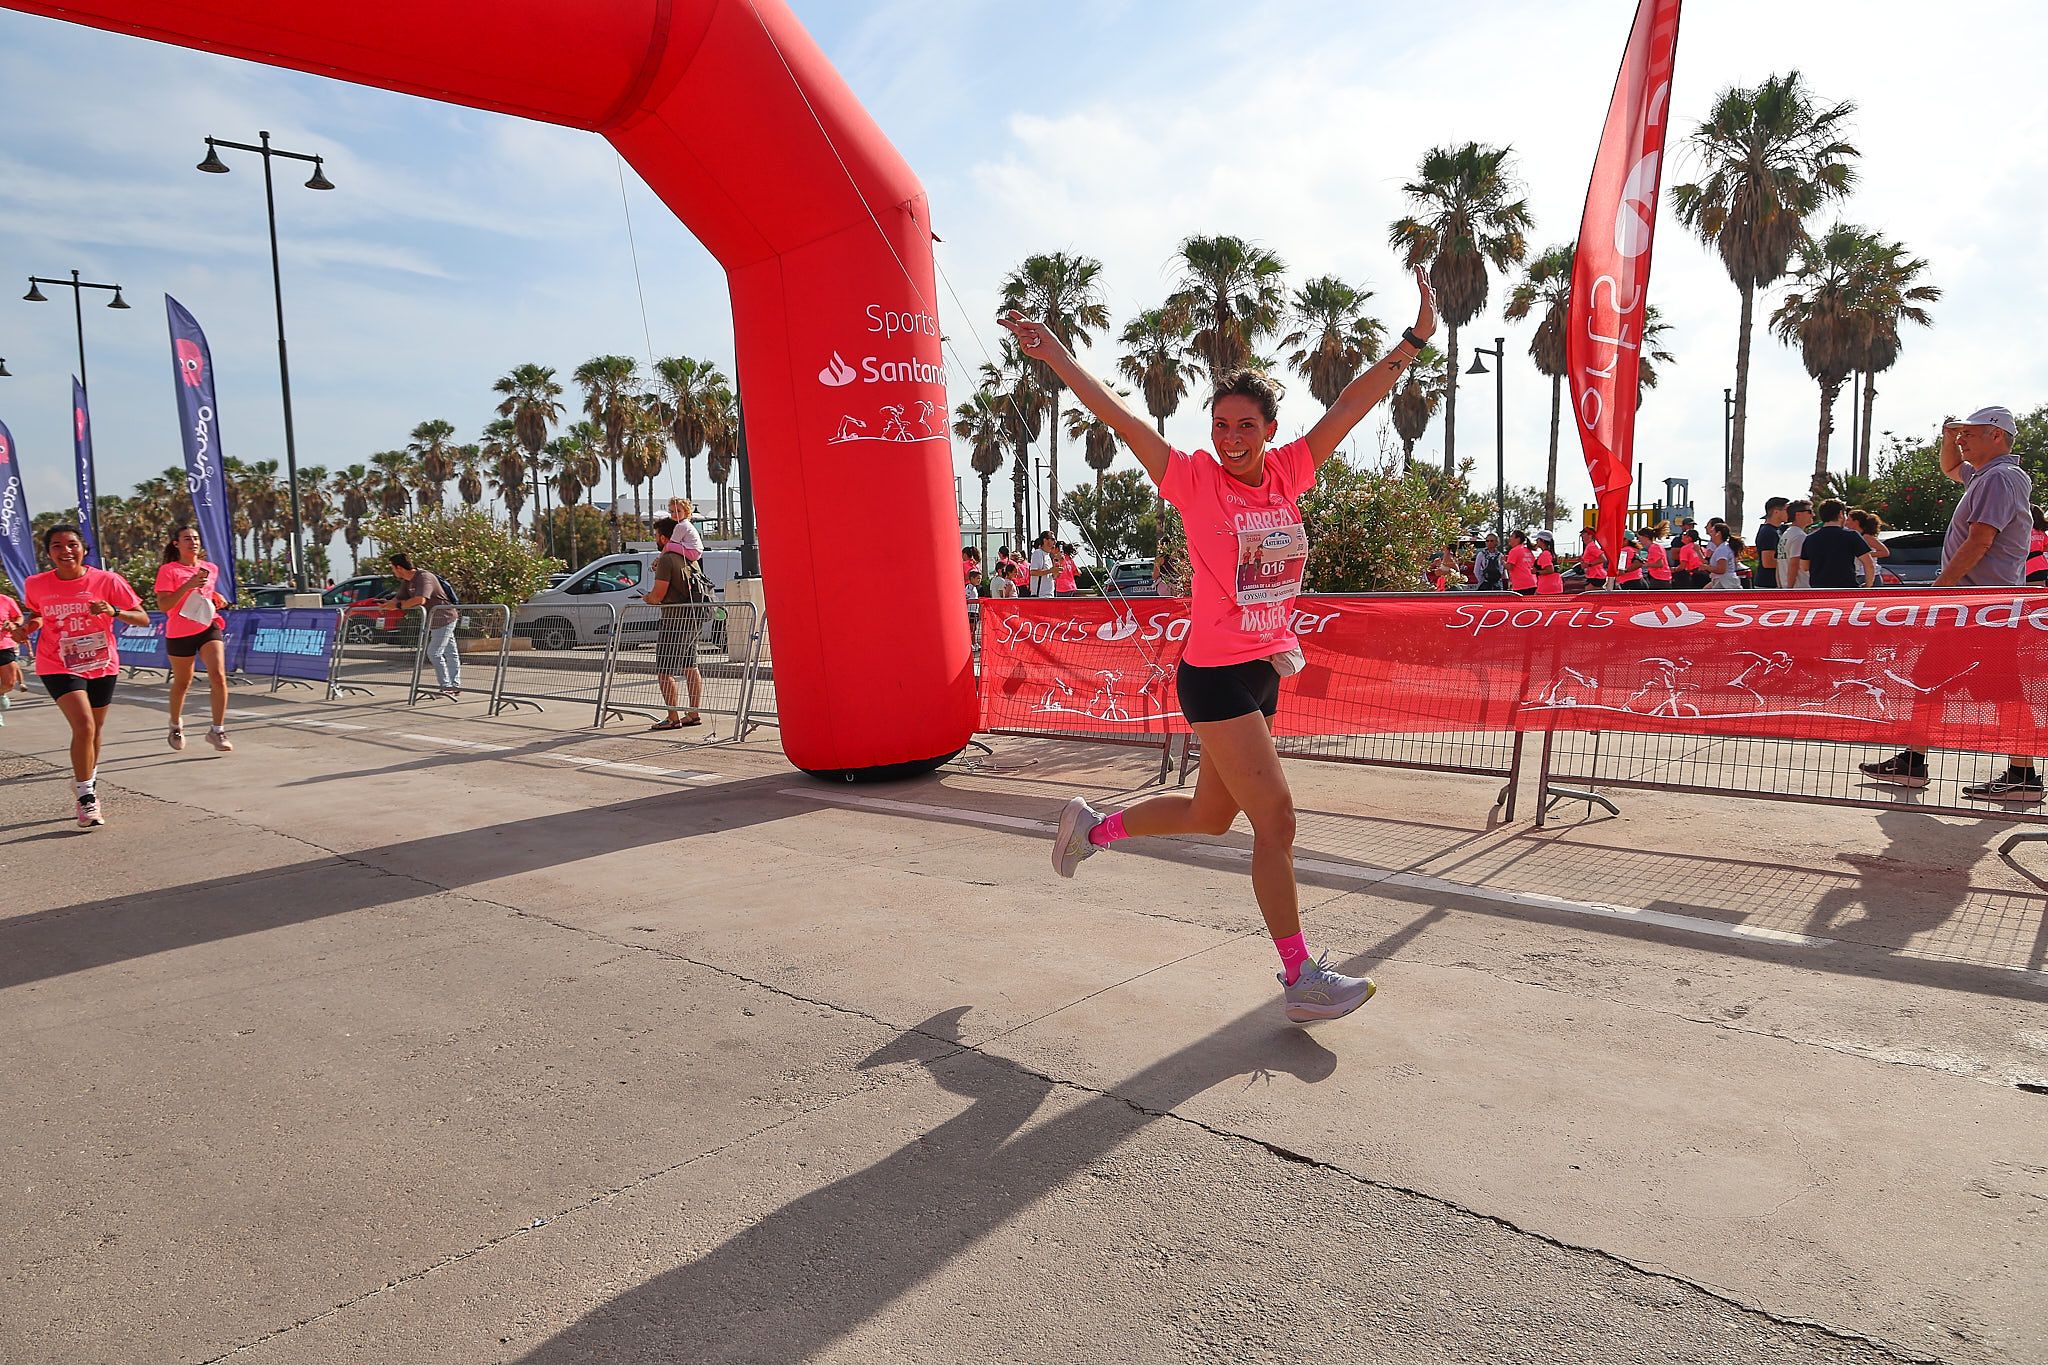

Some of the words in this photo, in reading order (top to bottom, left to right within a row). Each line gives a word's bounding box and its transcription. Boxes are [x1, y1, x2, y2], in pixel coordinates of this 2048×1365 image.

[865, 303, 936, 339] Sports
[861, 356, 947, 386] Santand
[1261, 560, 1286, 576] 016
[1243, 591, 1267, 601] OYSHO
[69, 617, 85, 632] DE
[1240, 605, 1287, 632] MUJER
[1445, 604, 1620, 636] Sports
[1715, 598, 2048, 631] Santand
[997, 614, 1093, 650] Sports
